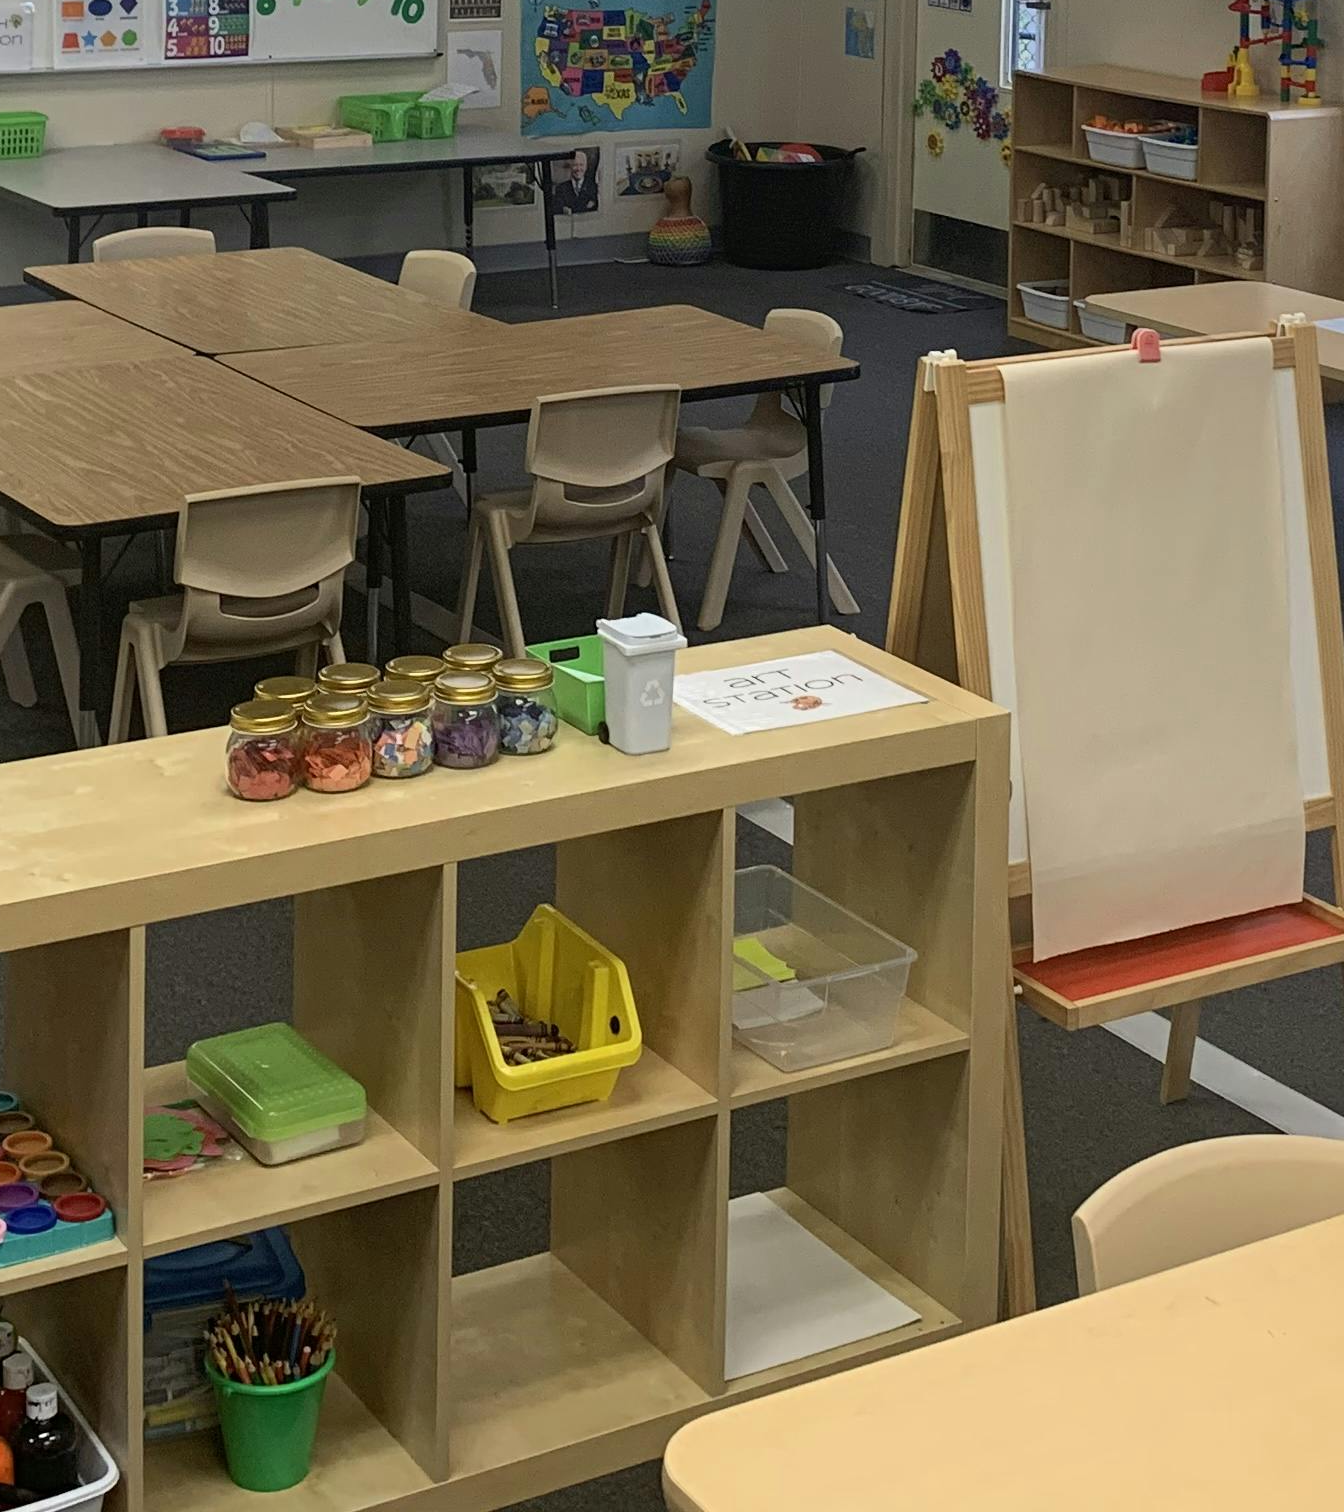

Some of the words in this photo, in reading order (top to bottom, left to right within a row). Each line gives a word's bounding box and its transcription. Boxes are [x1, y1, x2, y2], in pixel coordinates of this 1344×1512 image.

[167, 18, 179, 37] 4
[208, 16, 220, 35] 9
[166, 39, 178, 57] 5
[209, 36, 225, 56] 10
